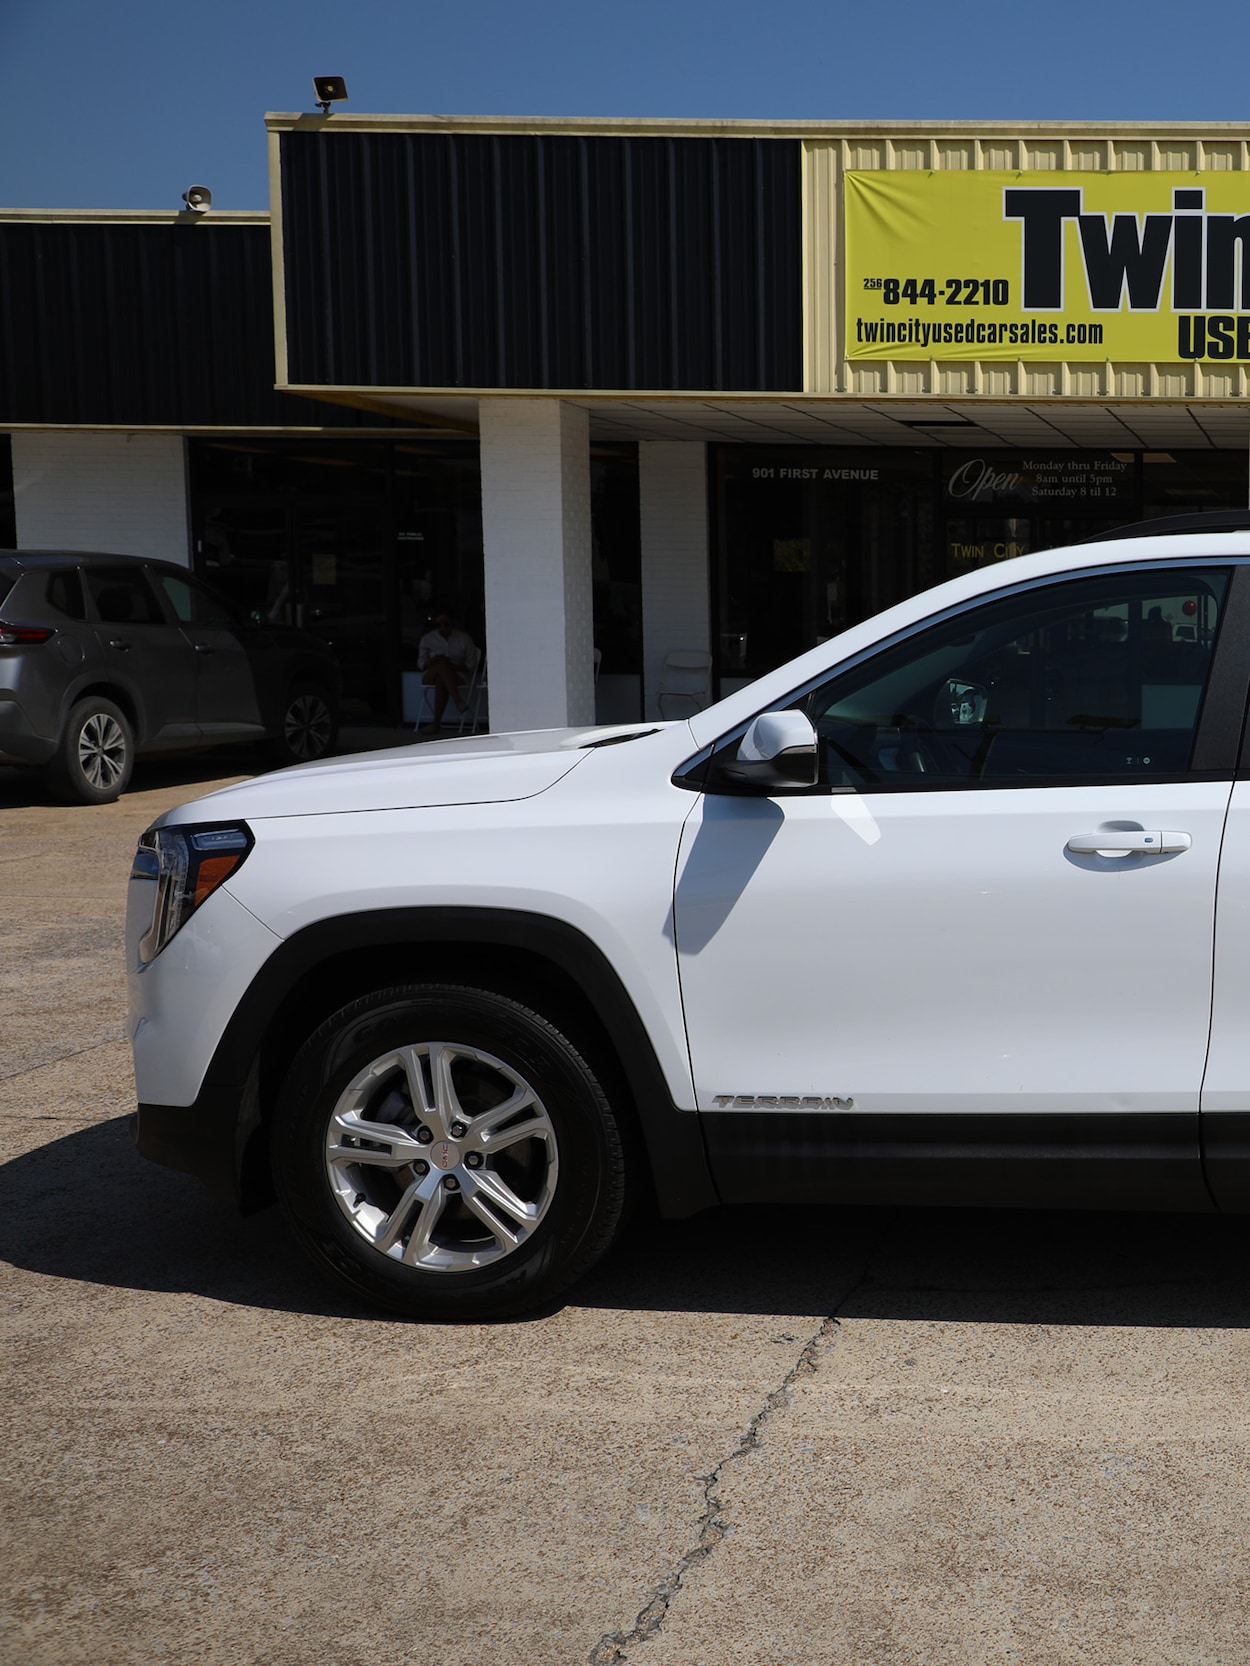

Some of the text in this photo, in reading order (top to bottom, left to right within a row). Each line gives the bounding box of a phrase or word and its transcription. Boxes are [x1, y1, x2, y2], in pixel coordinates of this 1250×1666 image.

[863, 278, 1009, 306] 256 844-2210
[856, 317, 1103, 347] twincityusedcarsales.com
[752, 467, 880, 480] 901 FIRST AVENUE
[1022, 460, 1128, 473] Monday thru Friday
[948, 458, 1024, 501] Open
[1035, 474, 1113, 486] 8am until 5pm
[1031, 486, 1117, 499] Saturday 8 til 12
[711, 1095, 854, 1110] TERRAIN
